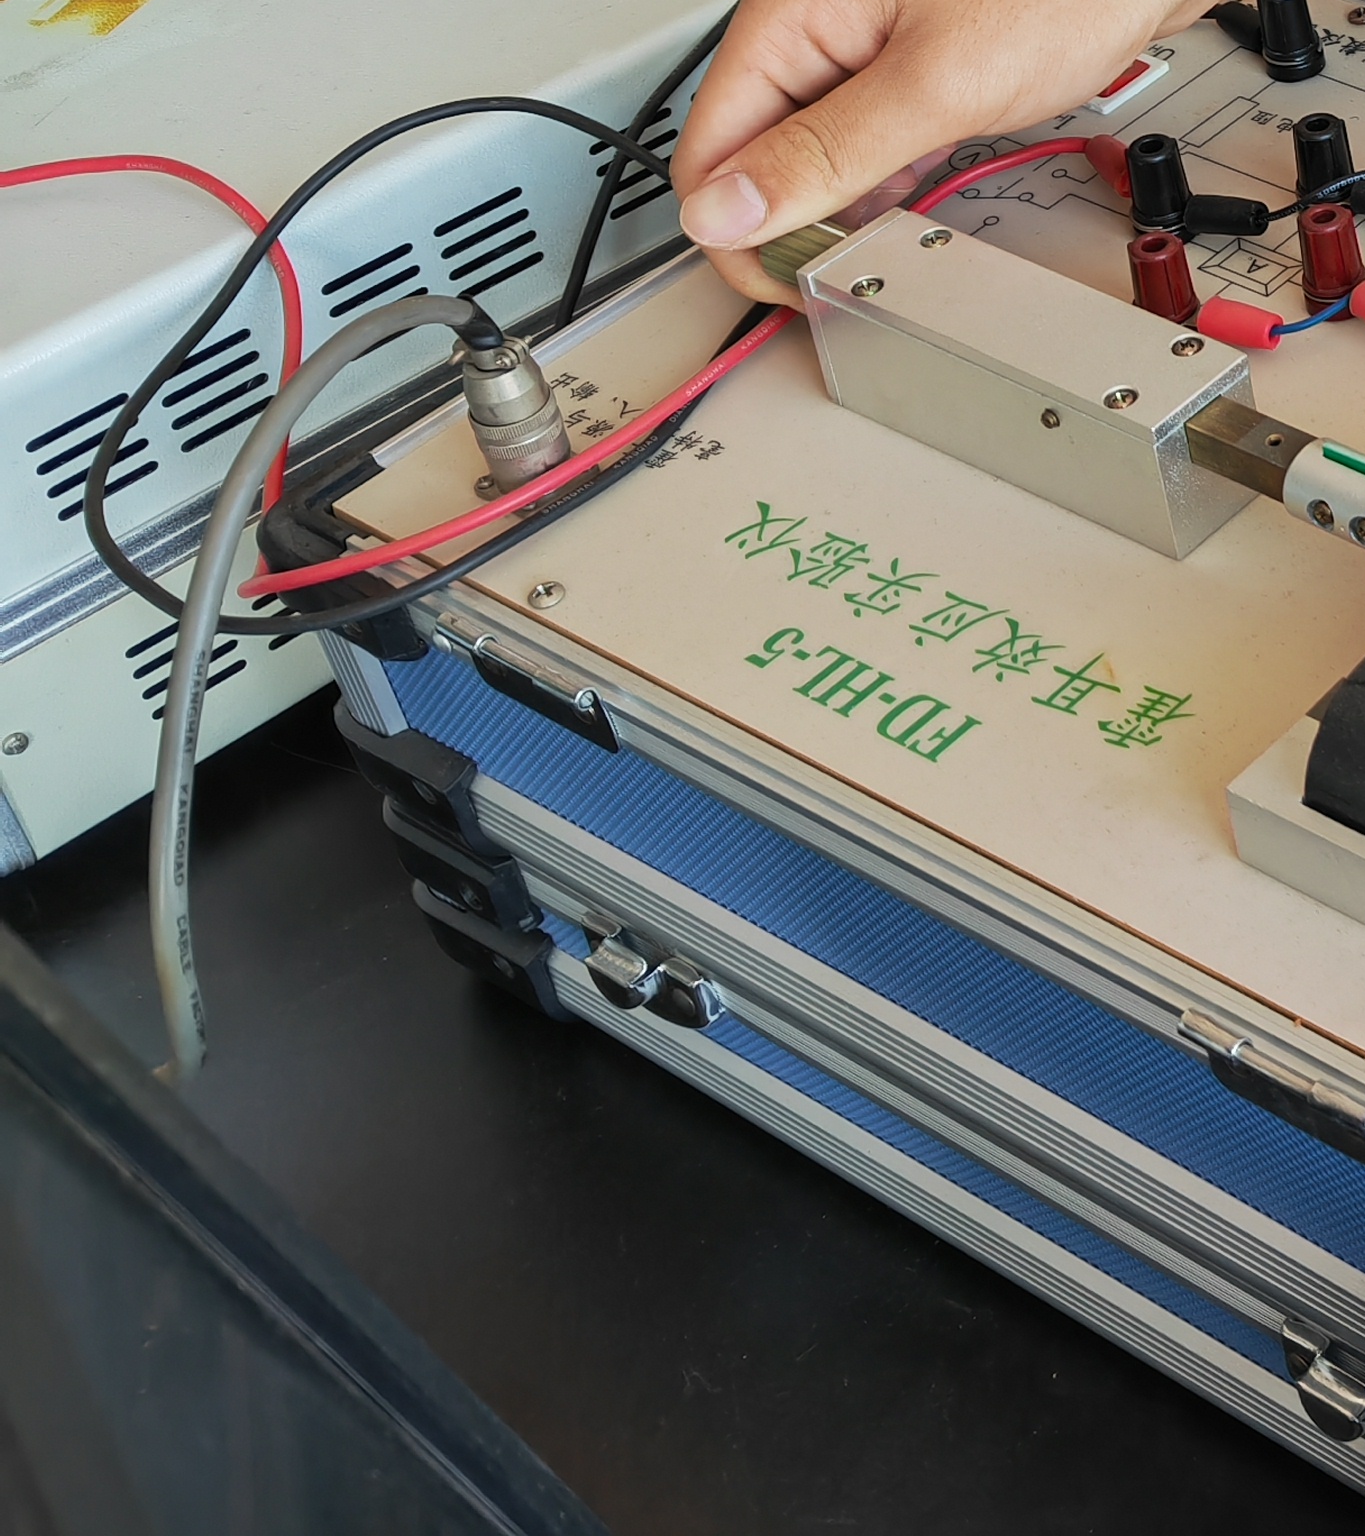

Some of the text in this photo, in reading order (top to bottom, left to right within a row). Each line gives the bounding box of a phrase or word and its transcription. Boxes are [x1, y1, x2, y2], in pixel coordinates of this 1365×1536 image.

[1250, 110, 1294, 134] 电阻
[725, 500, 1196, 748] 霍耳效应实验仪
[183, 649, 206, 754] SHANGHAI
[745, 626, 984, 764] FD-HL-5
